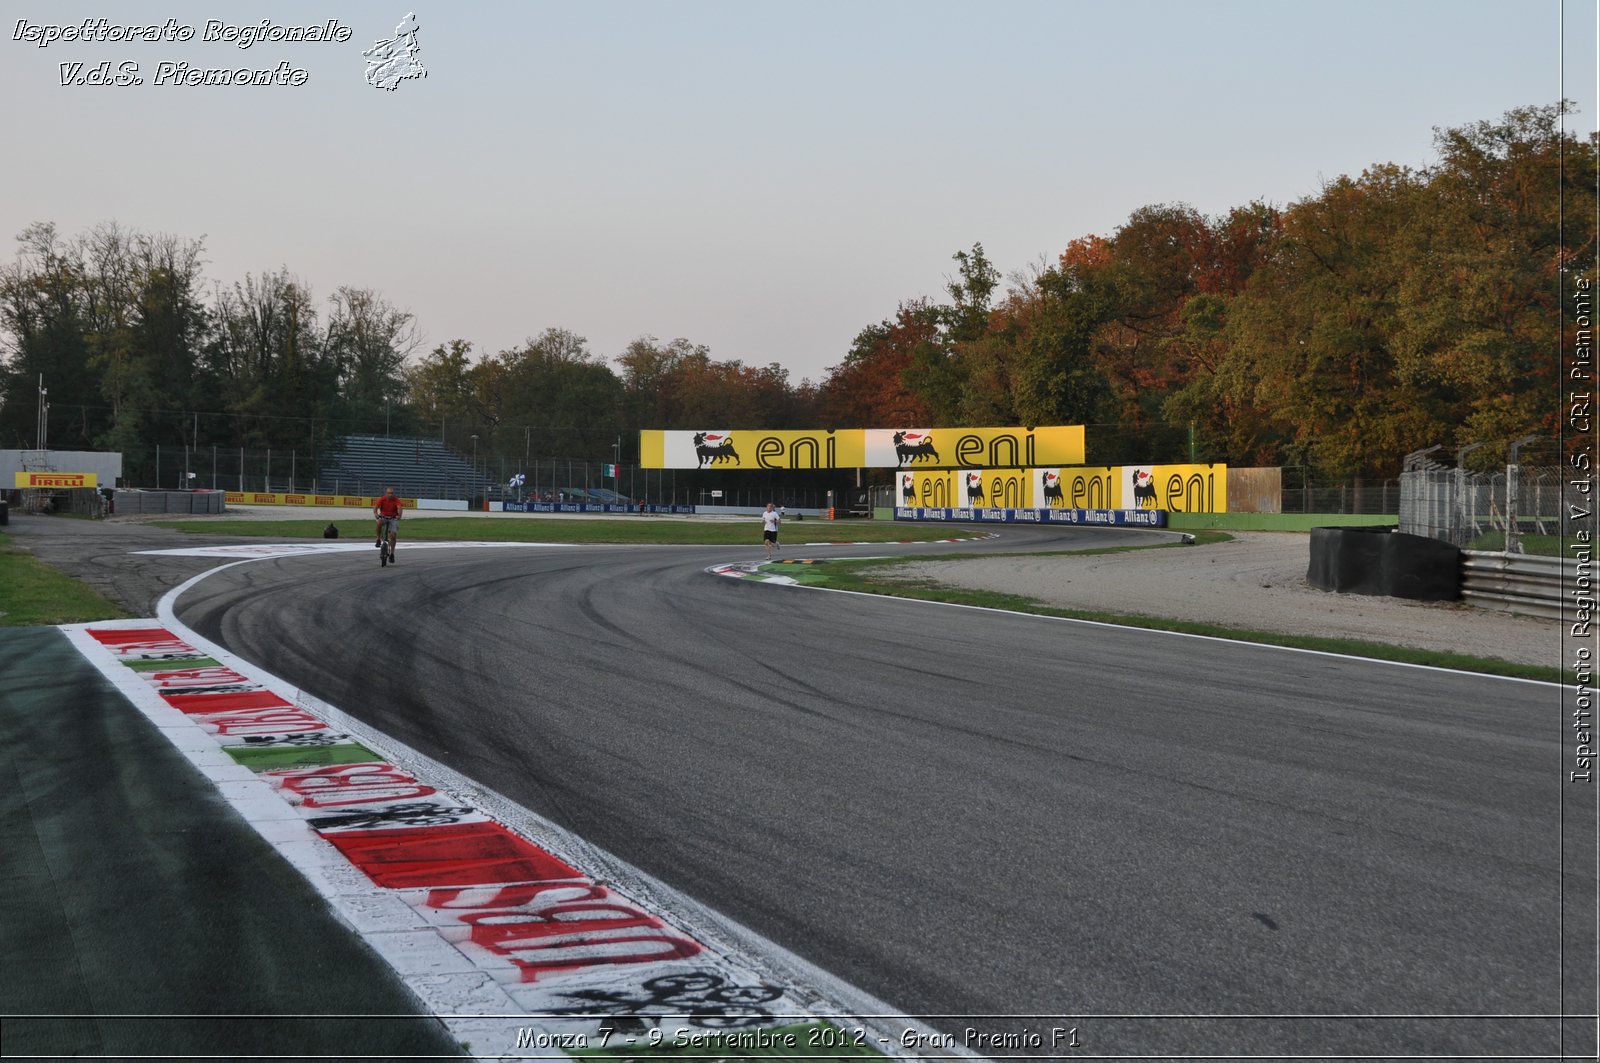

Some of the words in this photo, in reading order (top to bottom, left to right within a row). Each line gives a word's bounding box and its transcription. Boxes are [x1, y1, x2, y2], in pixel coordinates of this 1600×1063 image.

[756, 427, 836, 469] eni
[955, 423, 1036, 468] eni
[30, 474, 84, 487] PIRELLI
[922, 470, 950, 508] eni
[991, 467, 1025, 508] eni
[1072, 466, 1111, 509] eni
[1166, 463, 1214, 513] eni
[897, 508, 913, 518] Allianz
[923, 508, 941, 519] Allianz
[951, 509, 969, 519] Allianz
[981, 509, 1001, 520] Allianz
[1014, 509, 1034, 521] Allianz
[1049, 510, 1071, 521] Allianz
[1085, 510, 1108, 522] Allianz
[1124, 511, 1149, 523] Allianz
[425, 881, 703, 983] UBS
